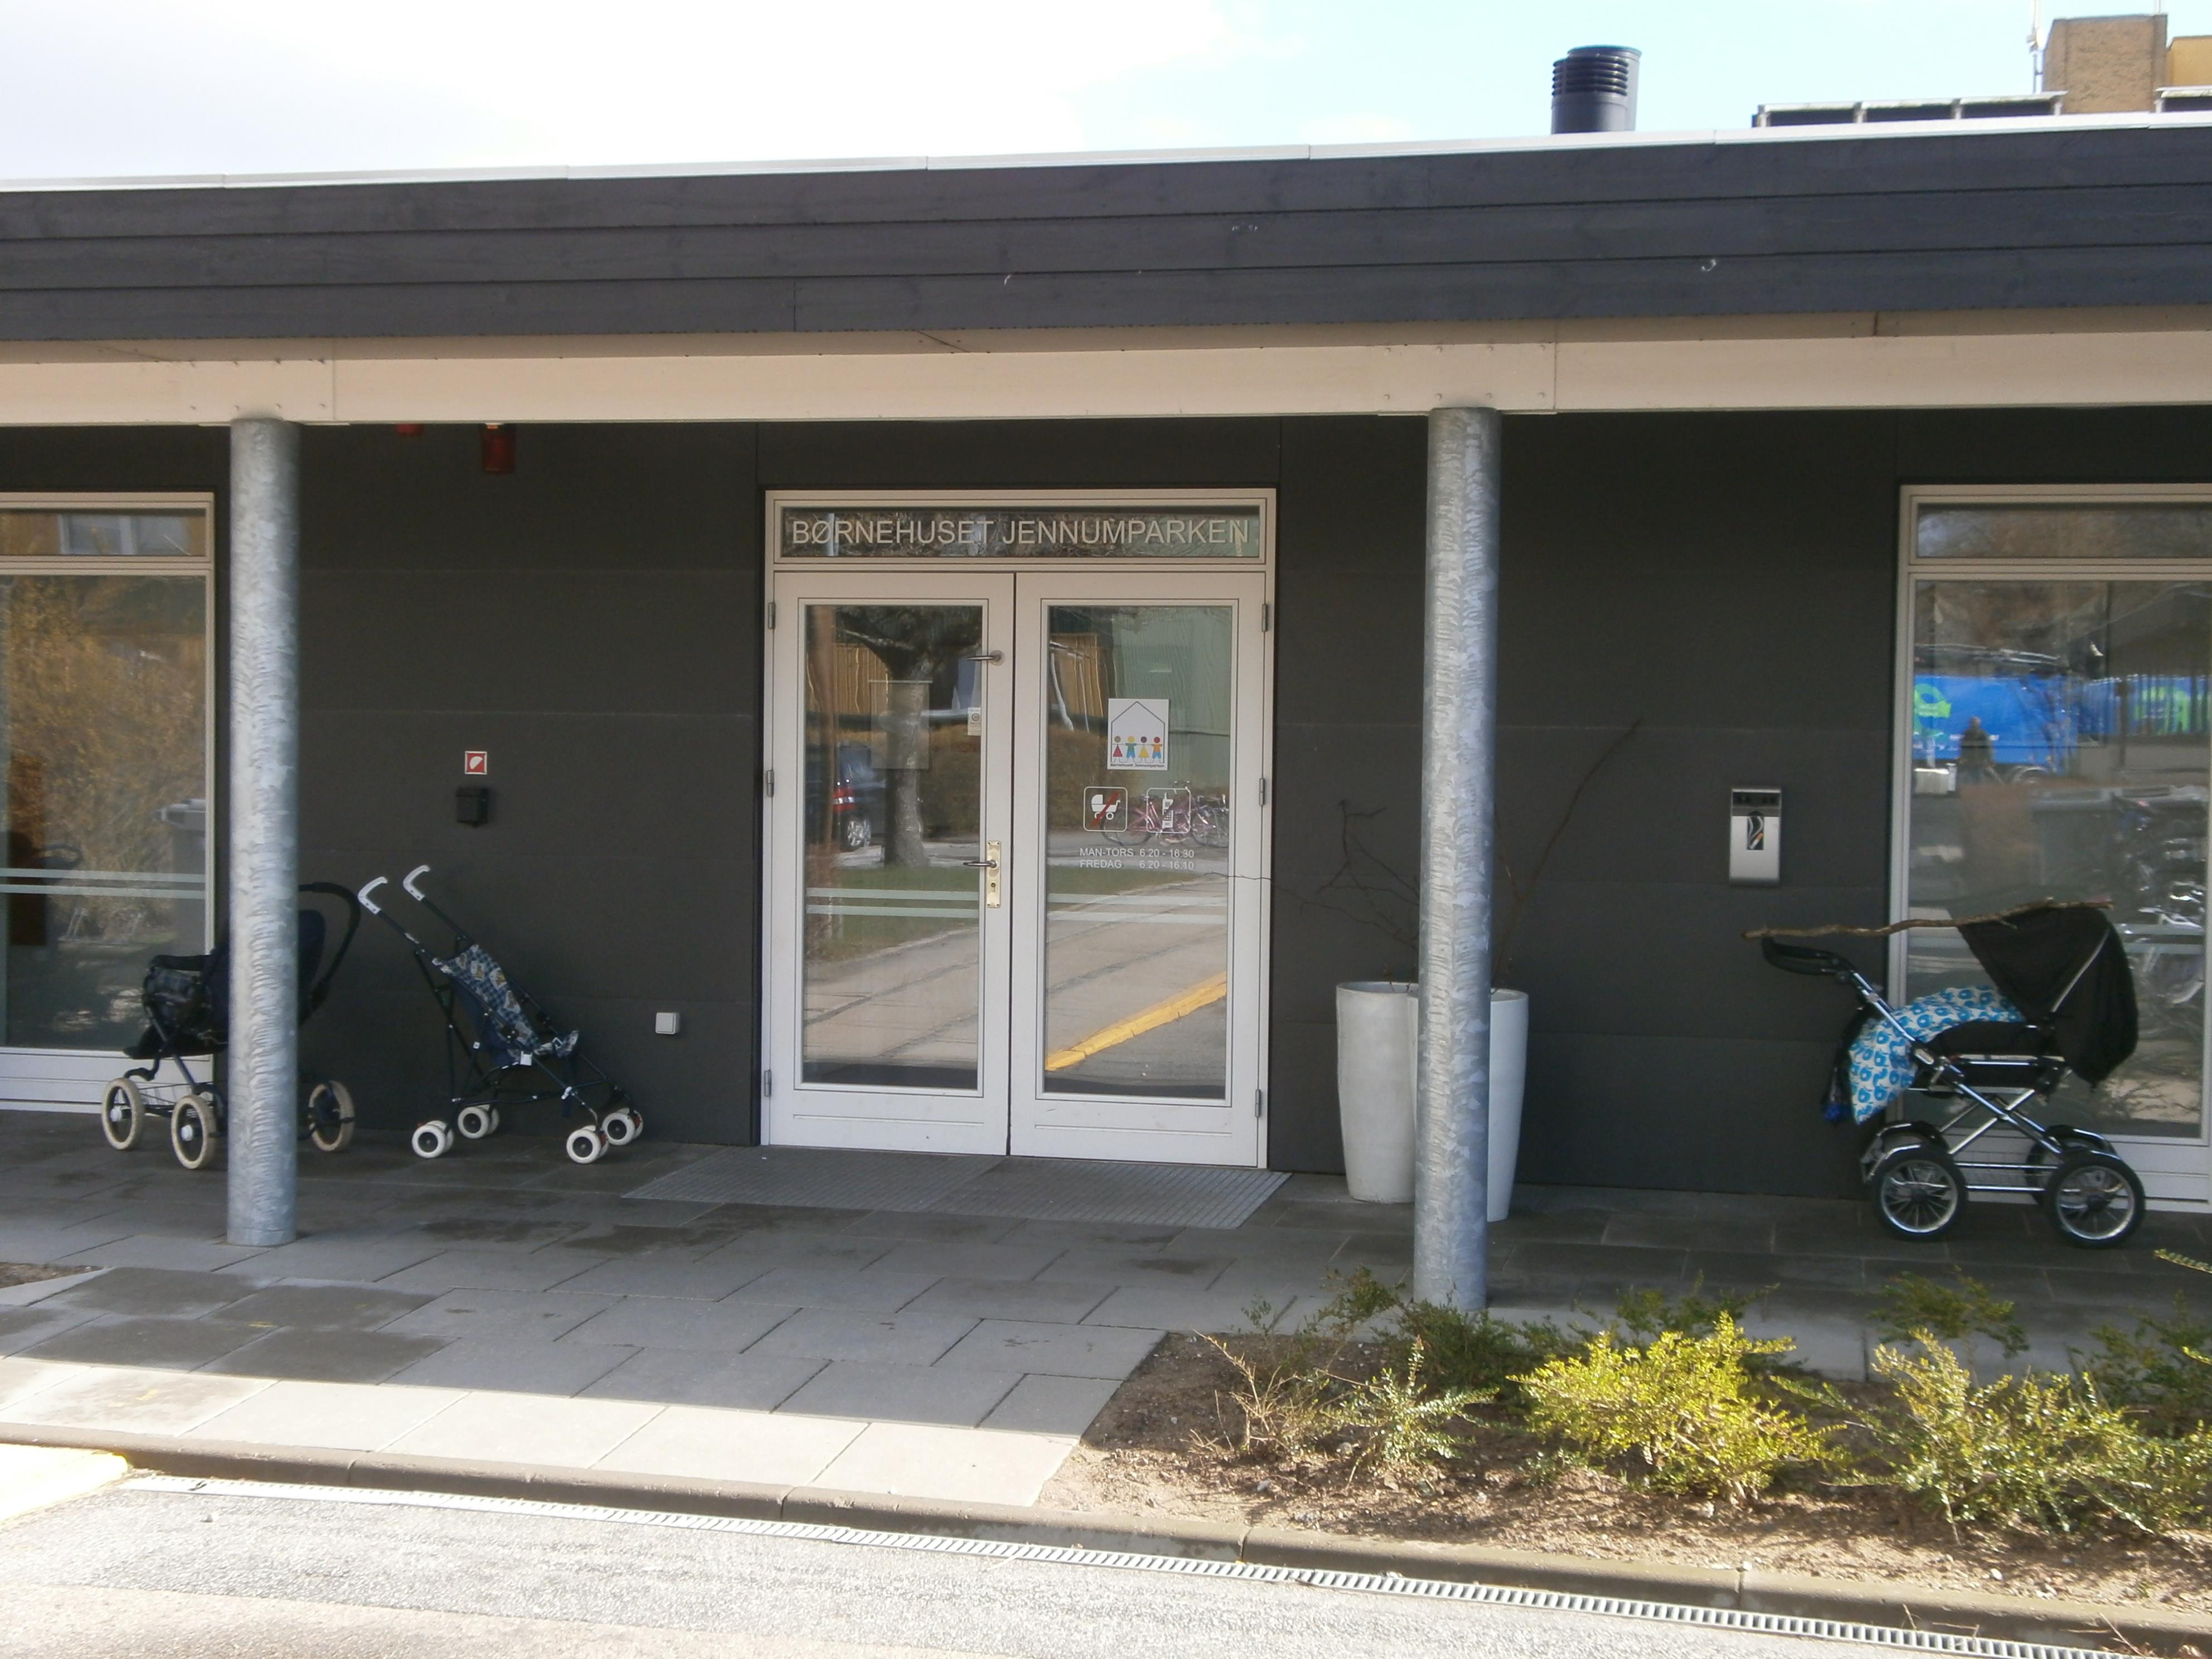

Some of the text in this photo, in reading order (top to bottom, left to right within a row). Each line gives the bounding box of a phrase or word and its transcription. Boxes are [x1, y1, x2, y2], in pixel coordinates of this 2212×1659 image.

[792, 520, 1248, 544] BØRNEHUSET JENNUMPARKEN
[1079, 847, 1134, 857] MAN-TORS
[1139, 848, 1160, 857] 6.20
[1079, 859, 1122, 869] FREDAG
[1139, 860, 1160, 869] 6.20
